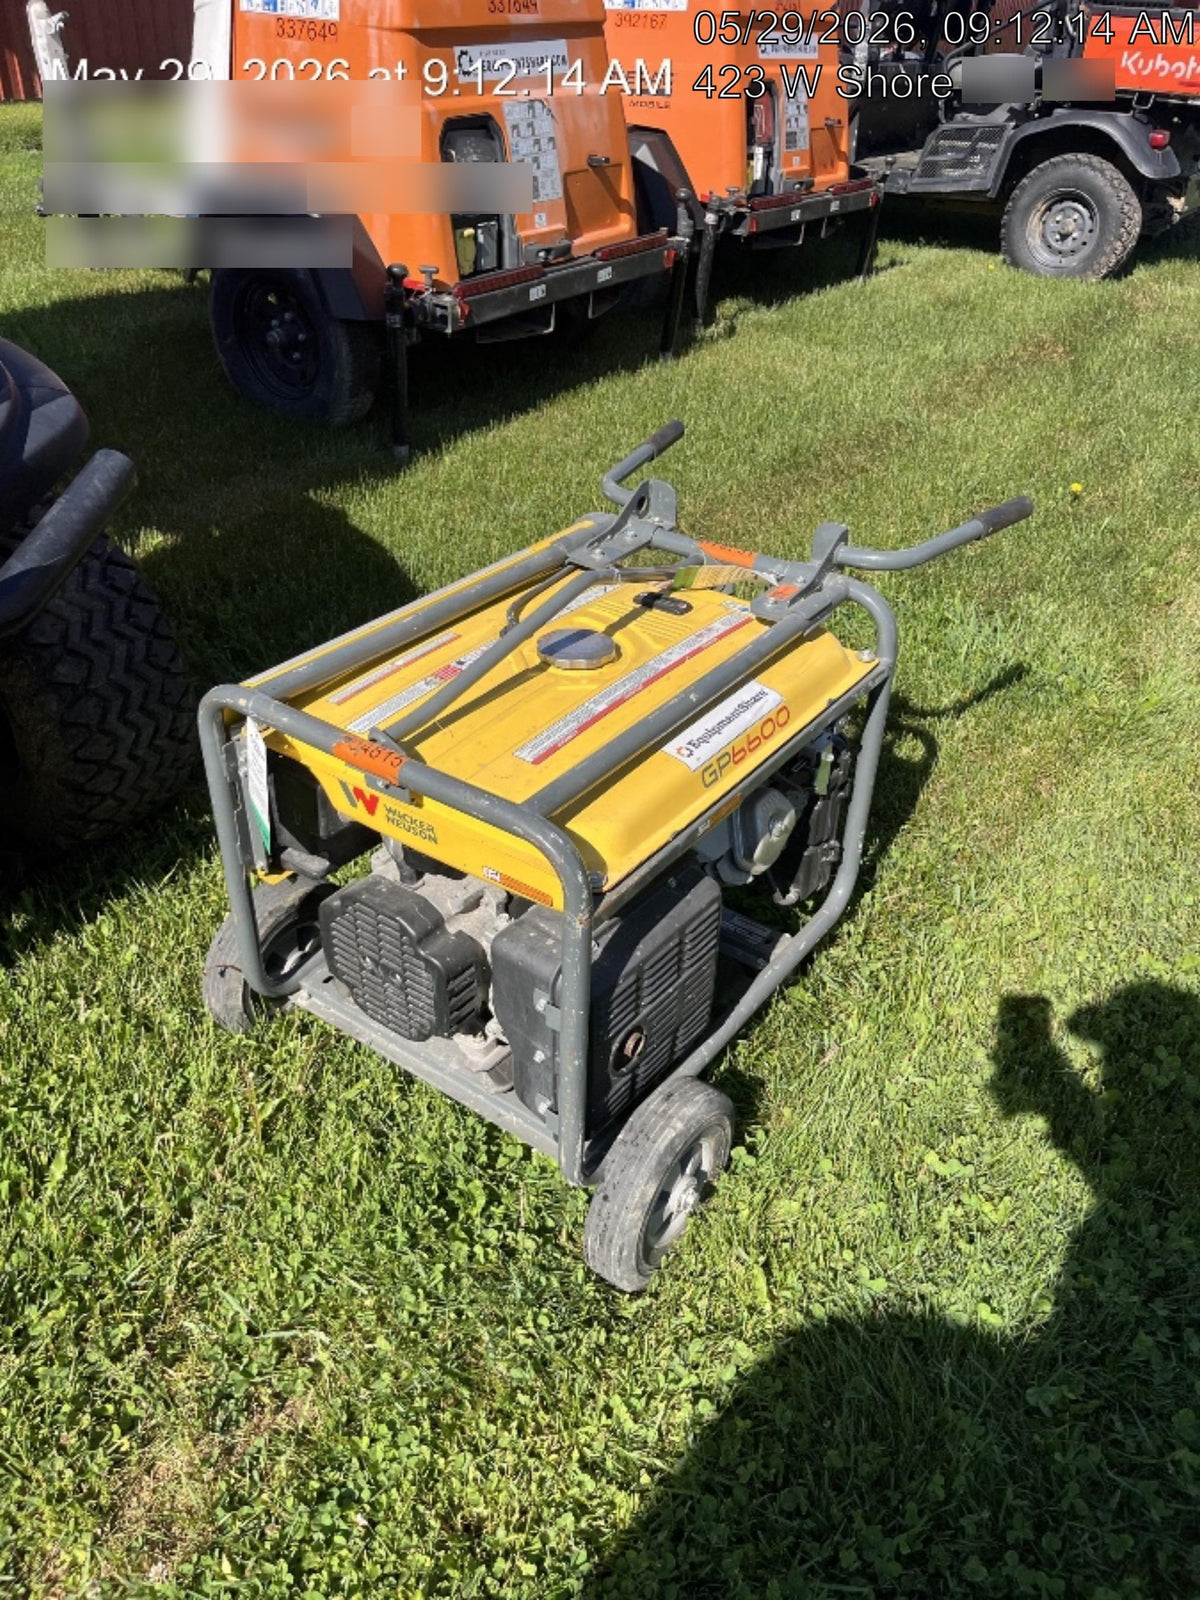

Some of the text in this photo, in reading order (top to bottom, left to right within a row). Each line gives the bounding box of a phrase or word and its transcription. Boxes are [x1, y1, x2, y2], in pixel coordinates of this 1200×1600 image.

[276, 17, 338, 42] 337649
[1120, 50, 1200, 79] Kubot
[701, 705, 790, 788] GP6600
[385, 814, 438, 845] NEUSON
